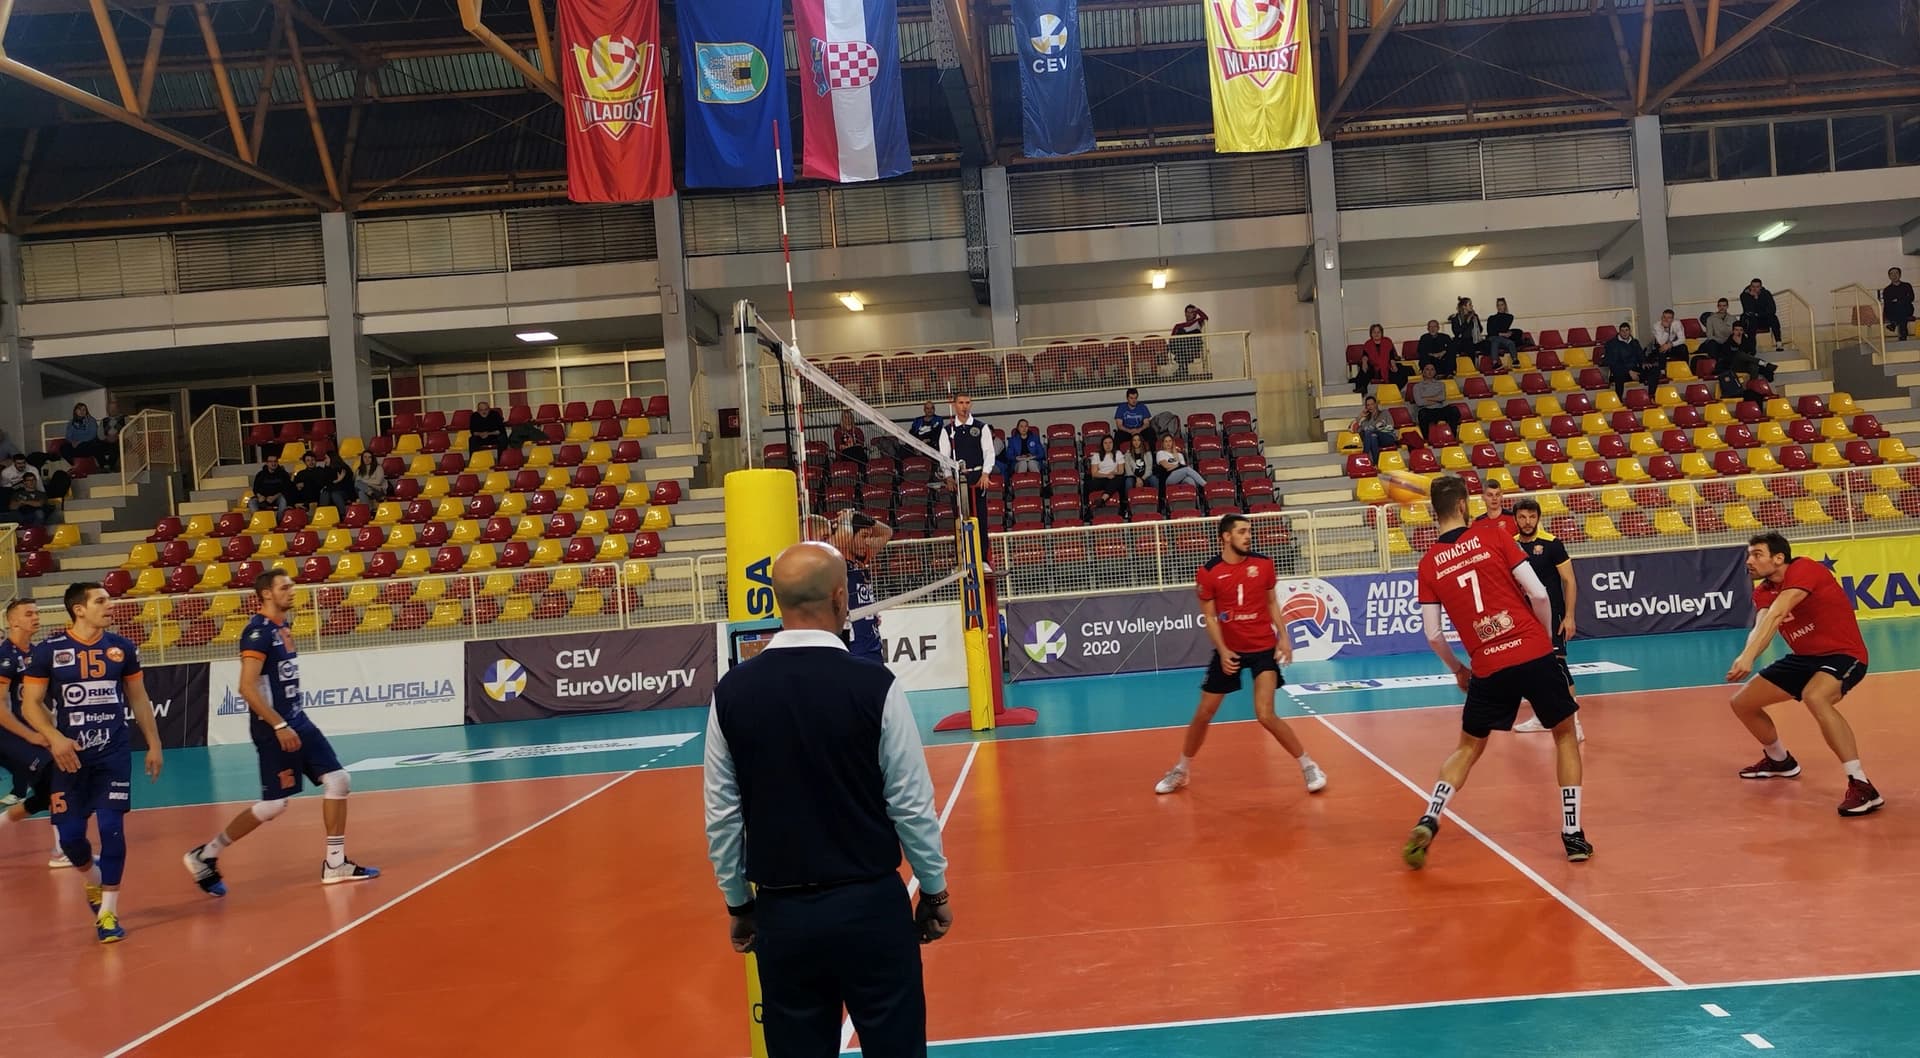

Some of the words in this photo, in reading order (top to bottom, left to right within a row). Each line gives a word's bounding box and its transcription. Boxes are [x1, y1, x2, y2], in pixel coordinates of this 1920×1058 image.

[1033, 55, 1068, 73] CEV
[1223, 45, 1299, 76] MLADOST
[1434, 535, 1481, 567] KOVAČEVIĆ
[1456, 568, 1485, 614] 7
[1591, 570, 1635, 592] CEV
[1236, 583, 1245, 606] 1
[1594, 590, 1734, 619] EuroVolleyTV
[1081, 620, 1114, 637] CEV
[1116, 614, 1193, 635] Volleyball
[555, 648, 601, 669] CEV
[1082, 639, 1121, 657] 2020
[76, 648, 107, 679] 15
[556, 668, 696, 697] EuroVolleyTV
[86, 712, 116, 724] triglav
